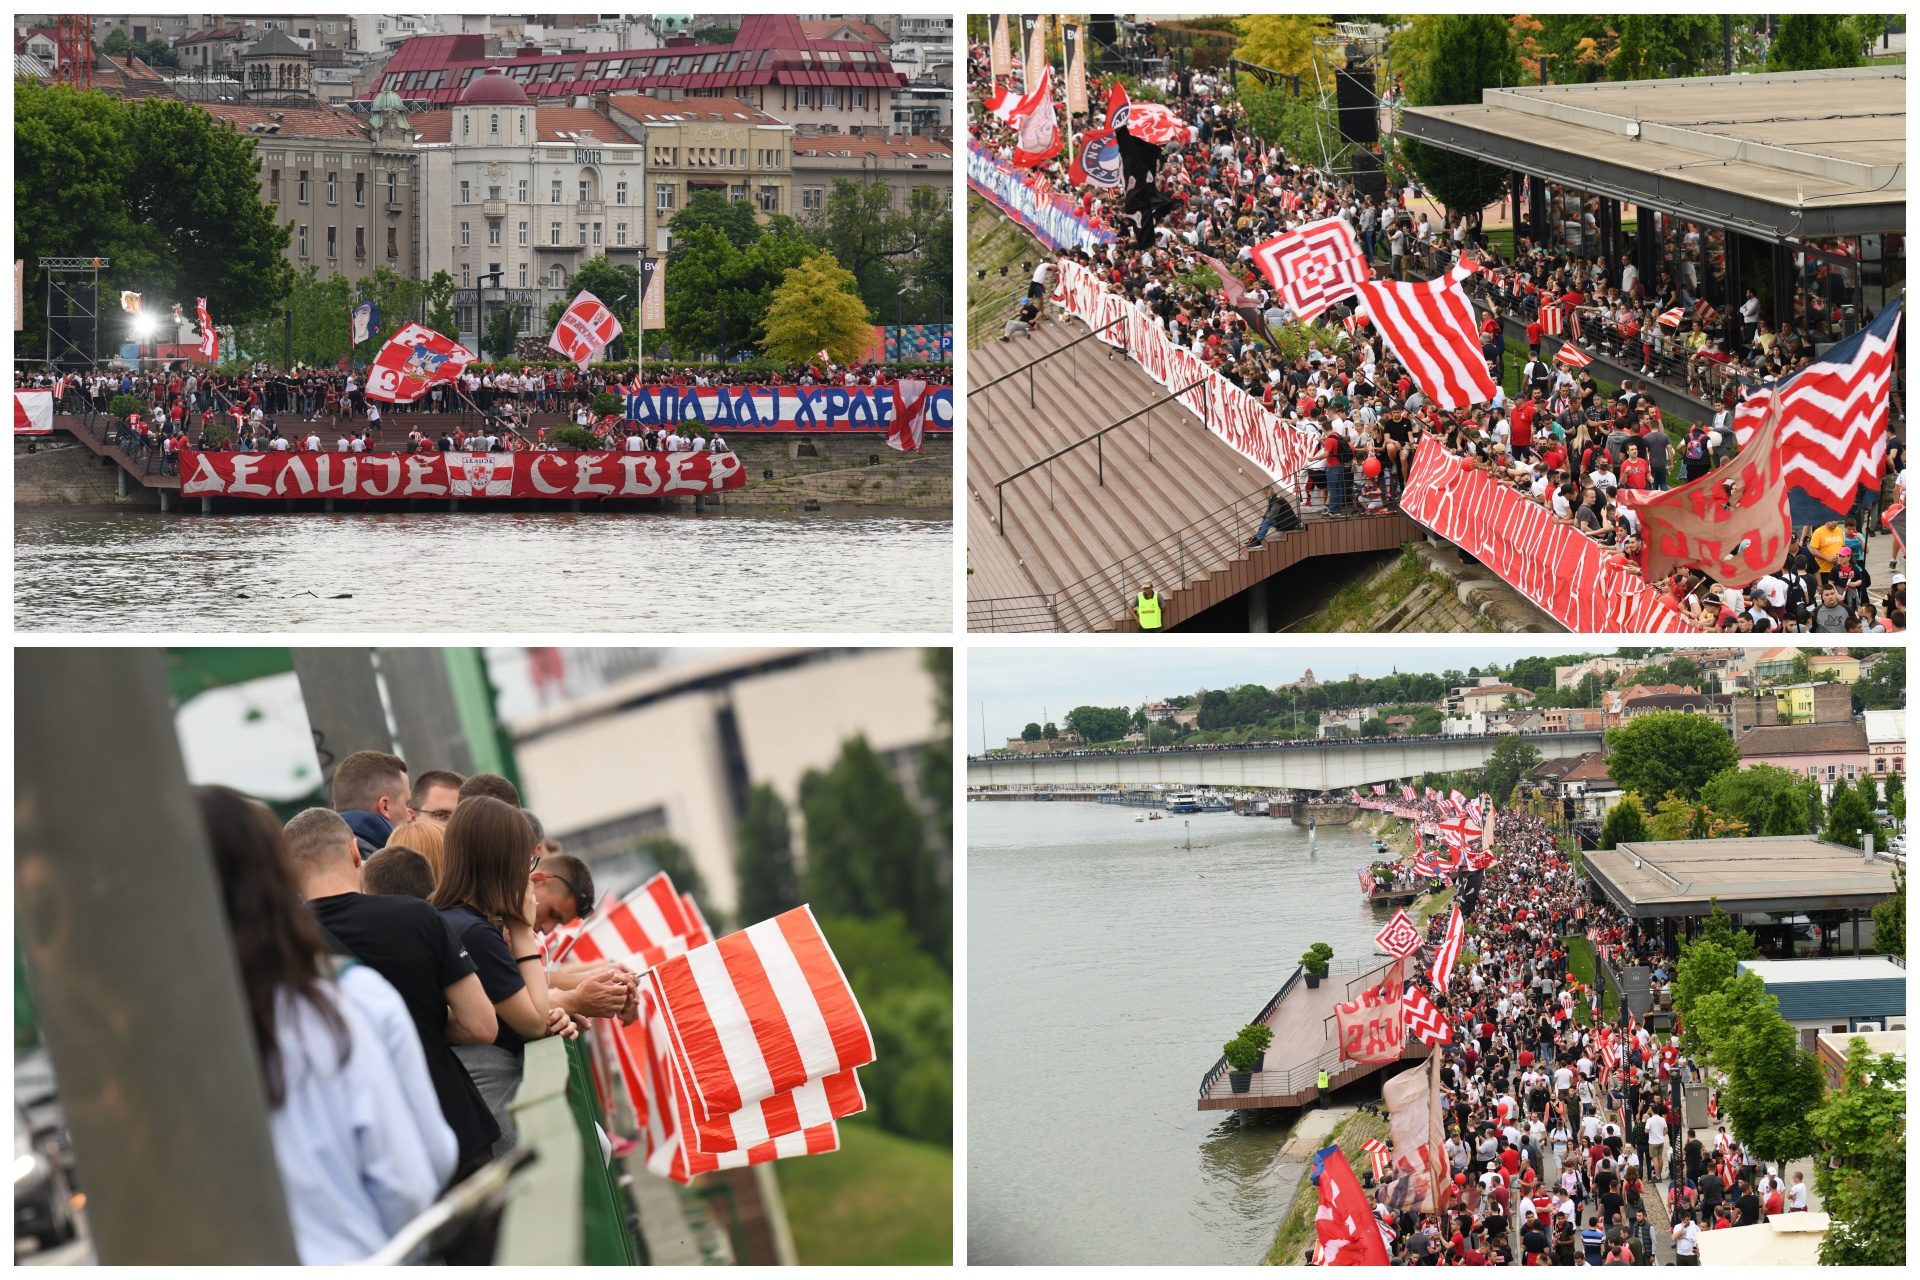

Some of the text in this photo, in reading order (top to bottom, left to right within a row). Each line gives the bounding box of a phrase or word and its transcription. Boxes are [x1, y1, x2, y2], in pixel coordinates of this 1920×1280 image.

[1026, 20, 1041, 29] BW
[1067, 30, 1080, 41] BW
[996, 30, 1004, 65] BELGRADE
[1073, 59, 1081, 101] BELGRADE
[575, 149, 605, 164] HOTEL
[644, 262, 662, 271] BW
[942, 338, 950, 348] P
[794, 387, 953, 429] ХРАБО
[183, 451, 742, 496] ДЕЛИЈЕ СЕВЕР
